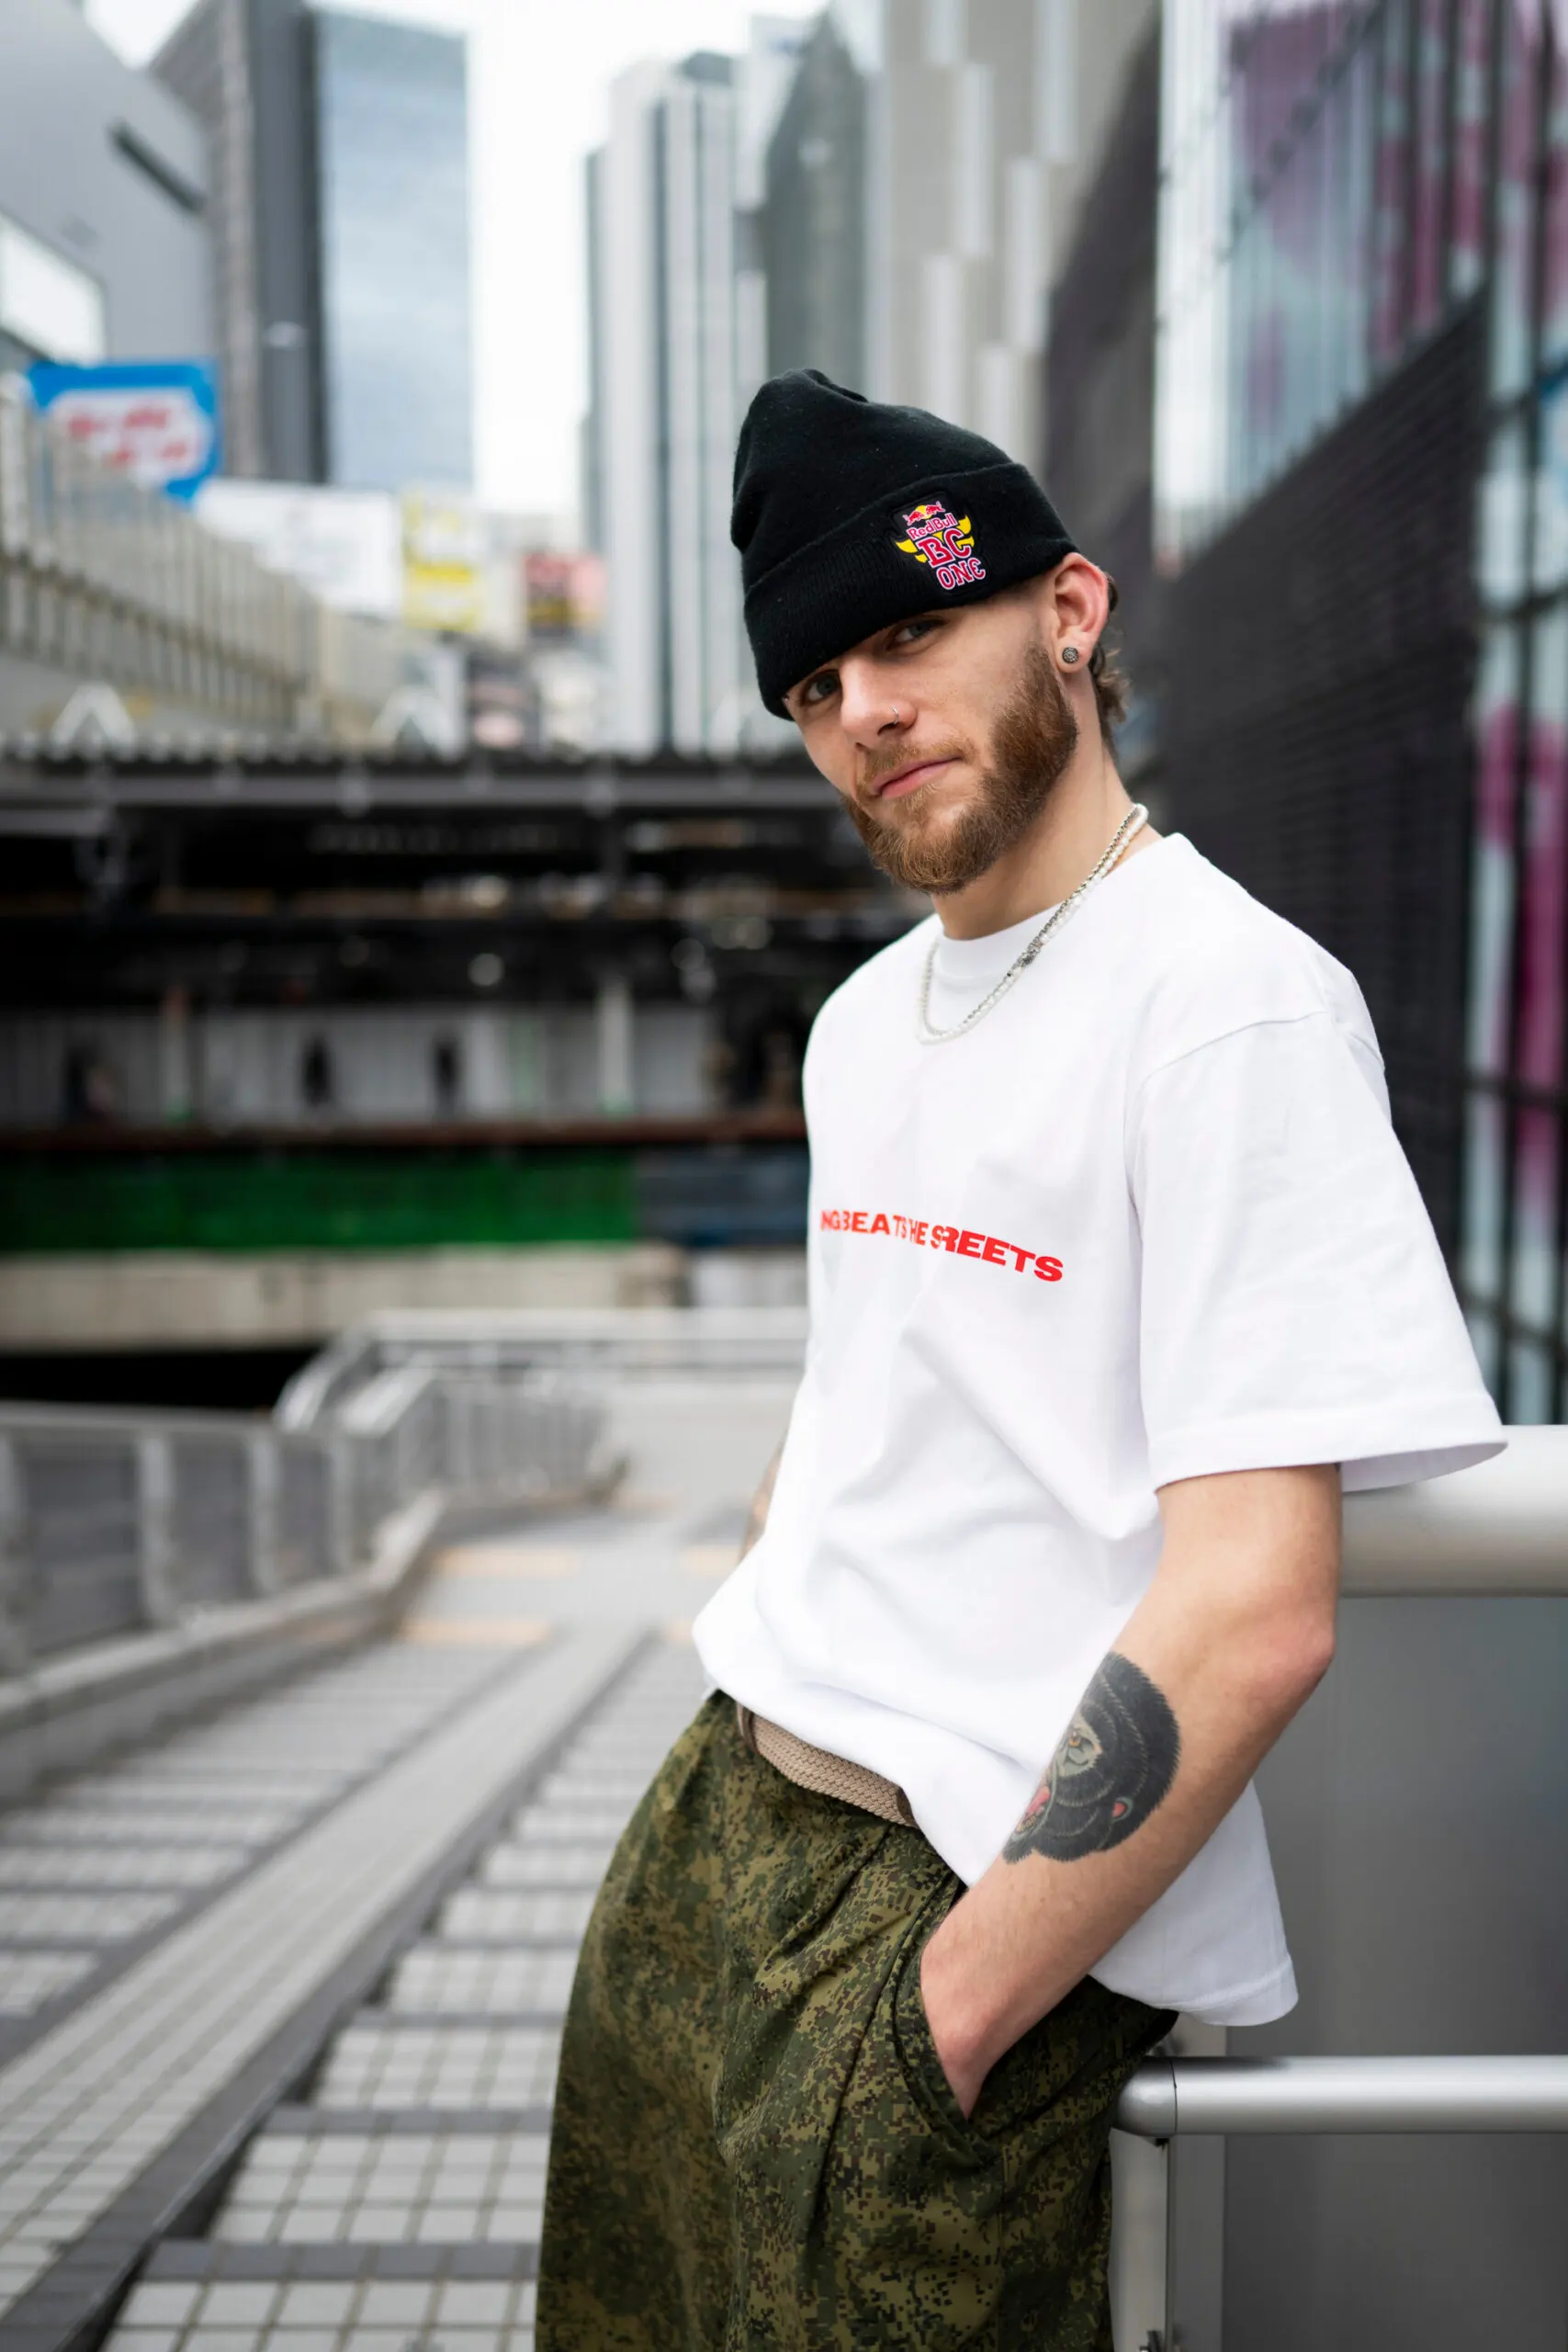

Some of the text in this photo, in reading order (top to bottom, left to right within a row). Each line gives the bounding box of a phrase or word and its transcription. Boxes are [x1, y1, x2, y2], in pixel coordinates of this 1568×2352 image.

[907, 513, 958, 539] Red Bull
[916, 528, 972, 569] BC
[936, 558, 986, 590] ONE
[930, 1225, 1064, 1283] SREETS
